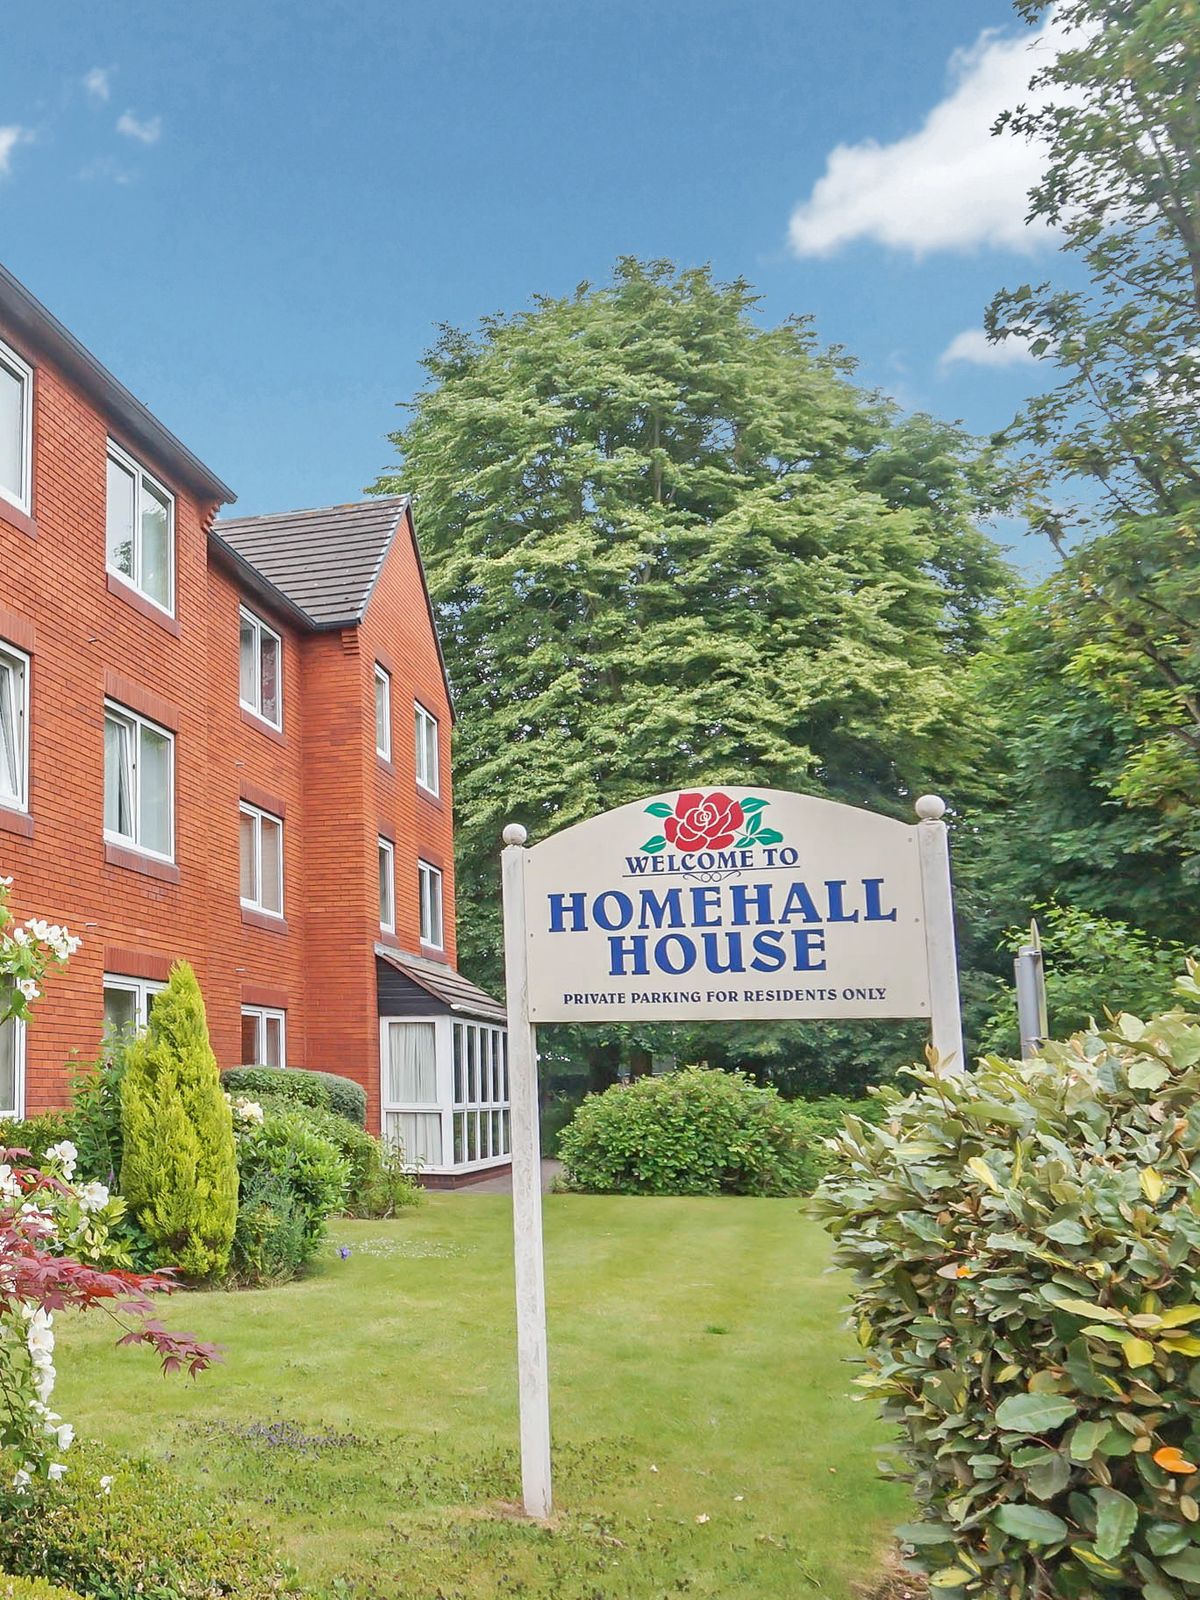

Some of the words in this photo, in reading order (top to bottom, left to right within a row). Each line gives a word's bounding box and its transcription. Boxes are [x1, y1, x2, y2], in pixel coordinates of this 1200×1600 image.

[625, 850, 753, 874] WELCOME
[763, 847, 799, 866] TO
[547, 878, 897, 933] HOMEHALL
[607, 928, 827, 976] HOUSE
[563, 992, 625, 1005] PRIVATE
[631, 991, 701, 1004] PARKING
[706, 990, 739, 1002] FOR
[744, 989, 837, 1001] RESIDENTS
[842, 988, 886, 1000] ONLY
